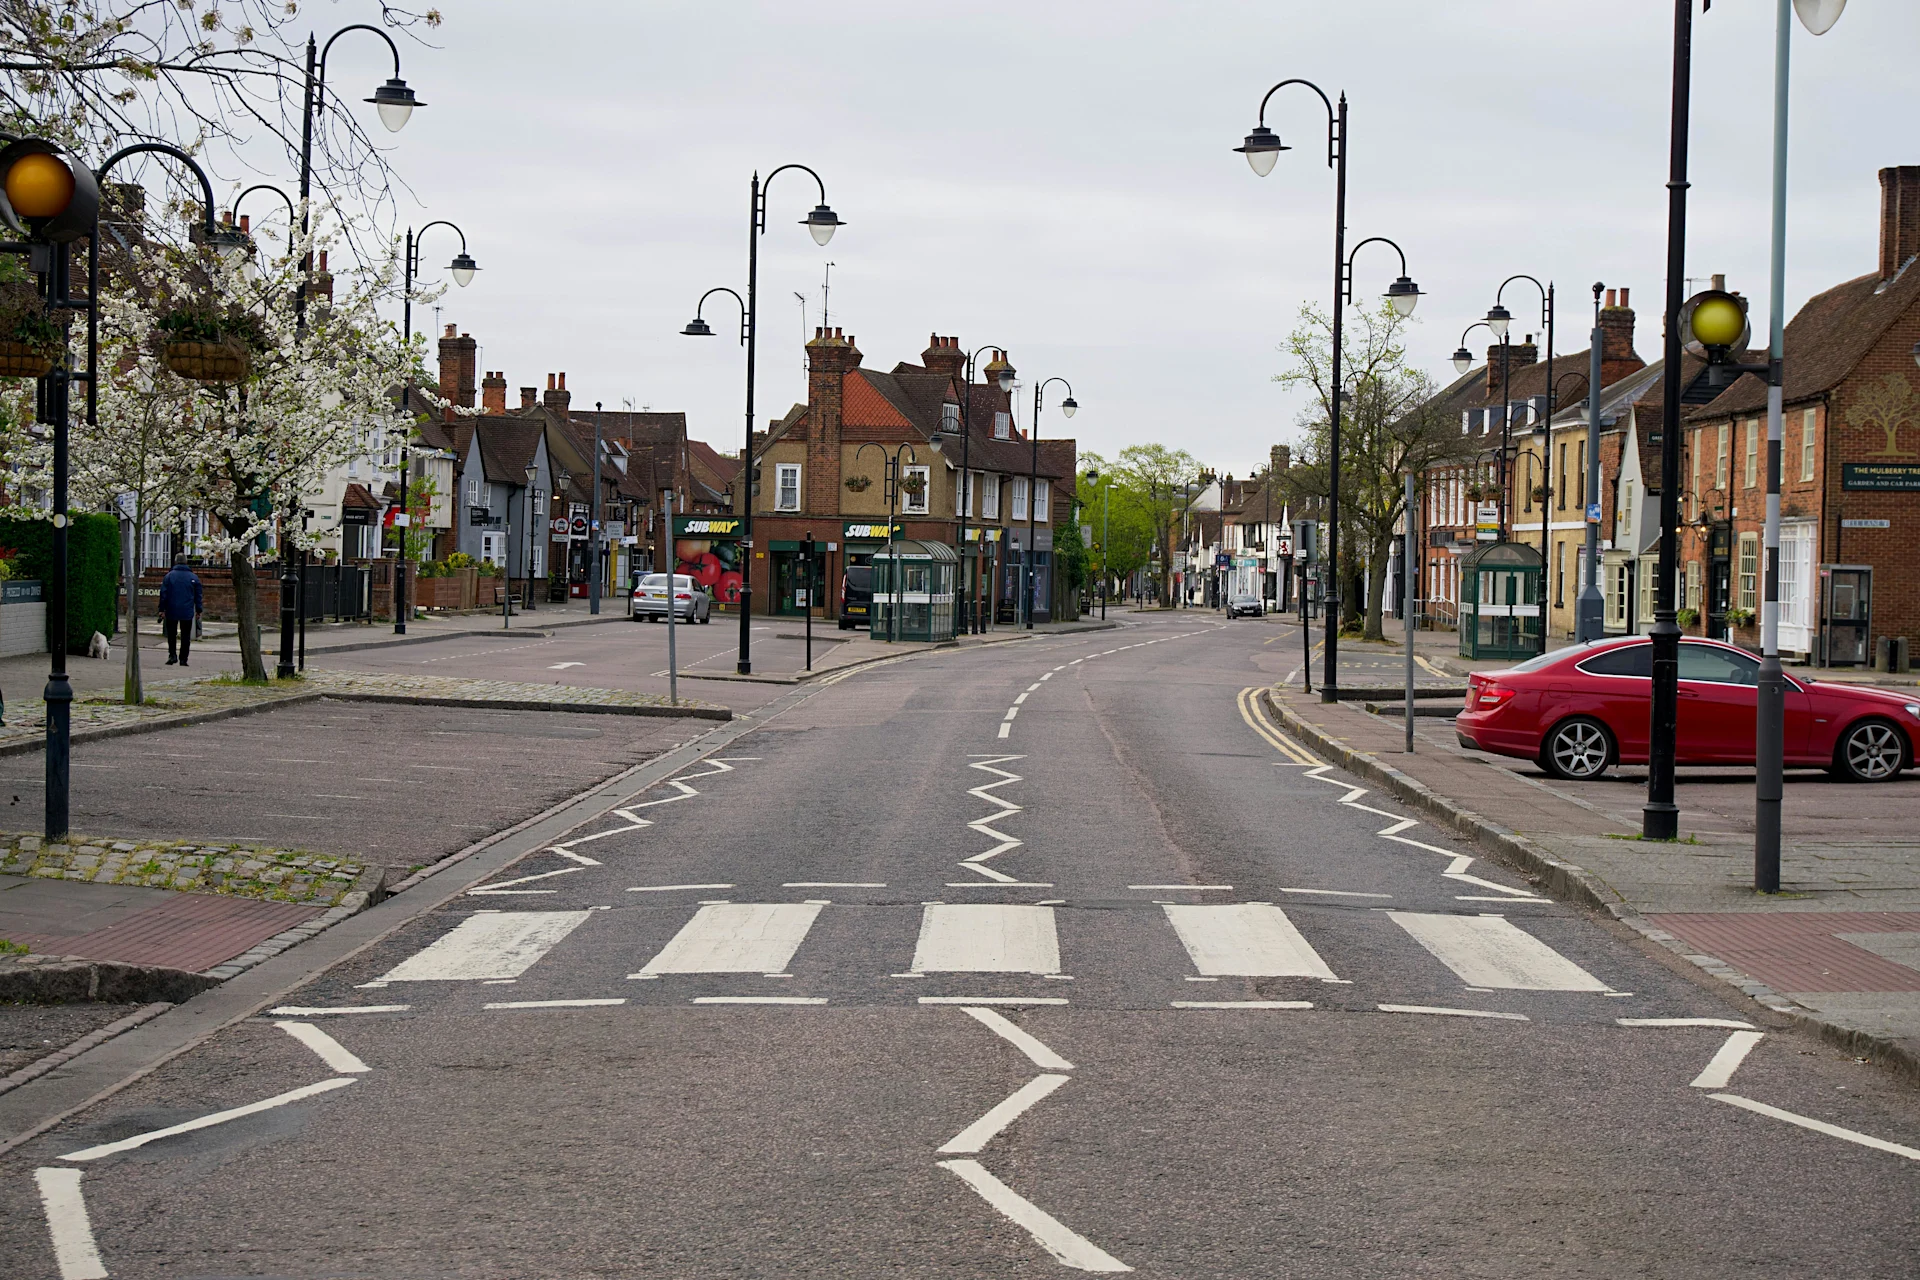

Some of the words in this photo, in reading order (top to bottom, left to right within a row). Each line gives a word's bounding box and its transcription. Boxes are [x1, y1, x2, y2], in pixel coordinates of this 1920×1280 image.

[1870, 467, 1907, 475] MULBERRY
[1908, 467, 1920, 475] TRE
[684, 520, 739, 533] SUBWAY
[845, 525, 900, 538] SUBWA
